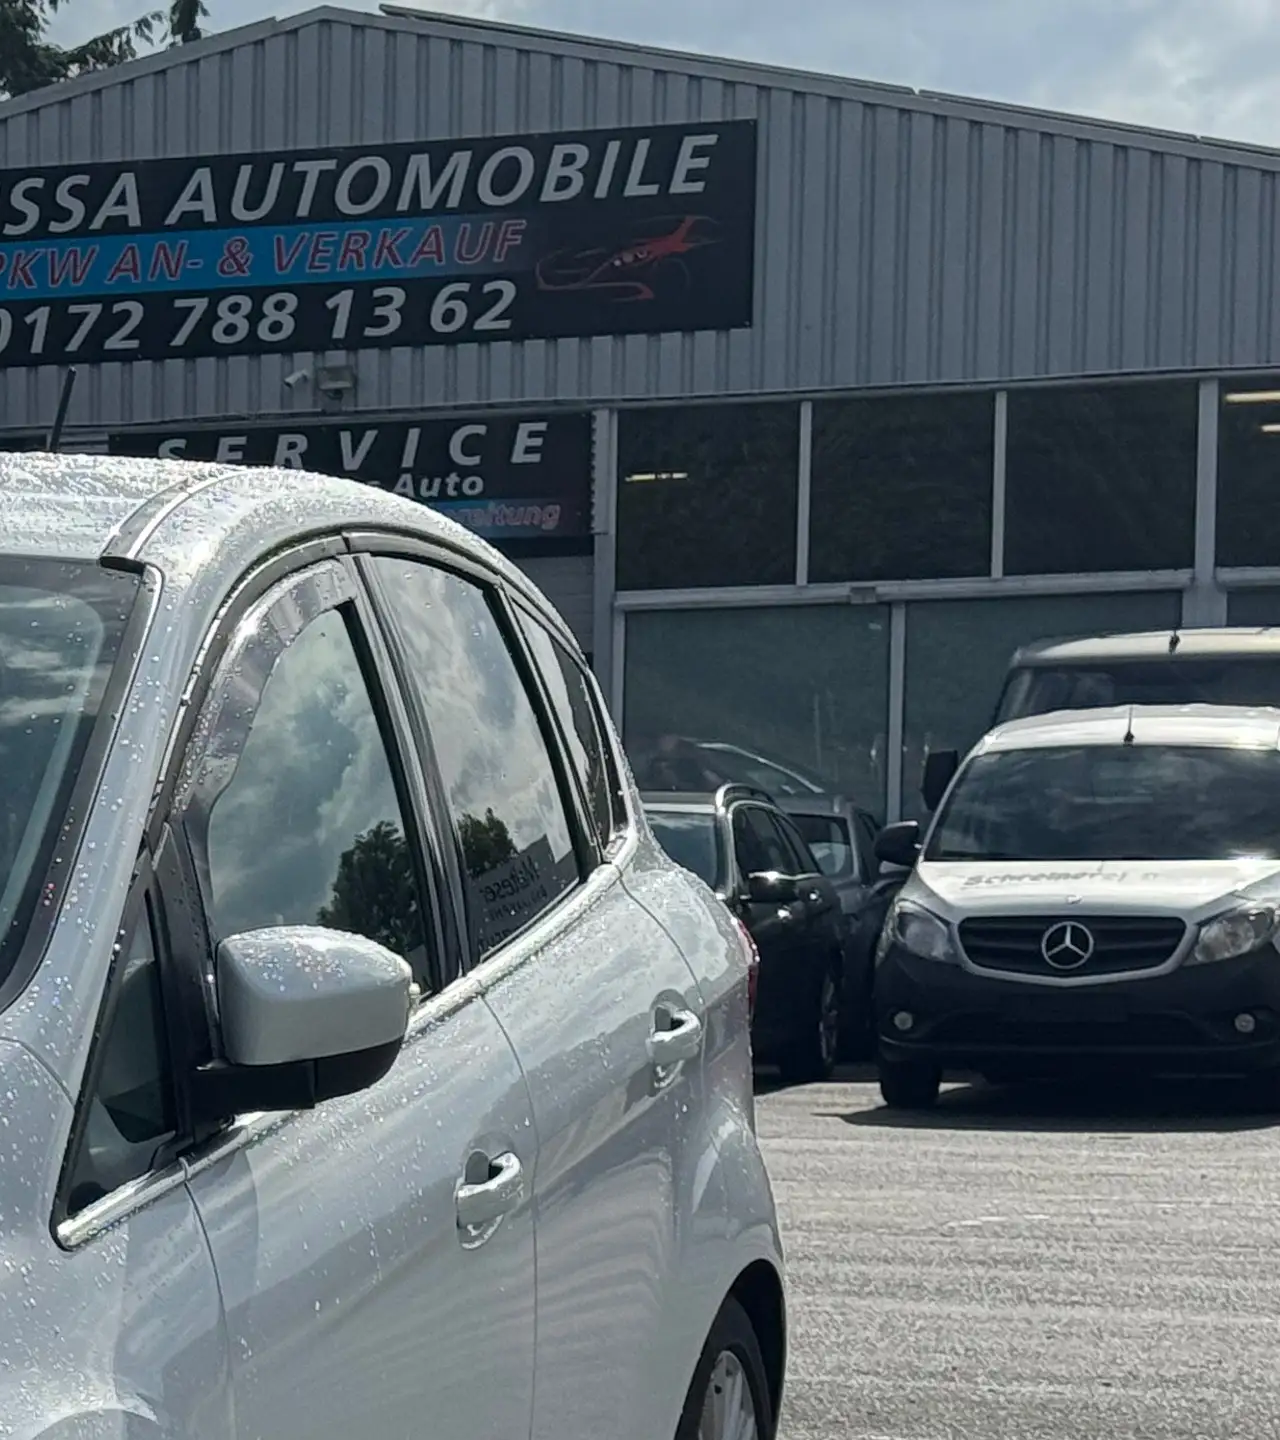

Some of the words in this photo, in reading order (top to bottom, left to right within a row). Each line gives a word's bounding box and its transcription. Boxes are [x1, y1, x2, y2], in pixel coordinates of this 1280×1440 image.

[164, 133, 719, 227] AUTOMOBILE
[105, 238, 204, 284] AN-
[216, 236, 253, 278] &
[273, 219, 527, 274] VERKAUF
[169, 292, 299, 348] 788
[325, 286, 407, 340] 13
[429, 279, 518, 334] 62
[393, 472, 484, 498] Auto
